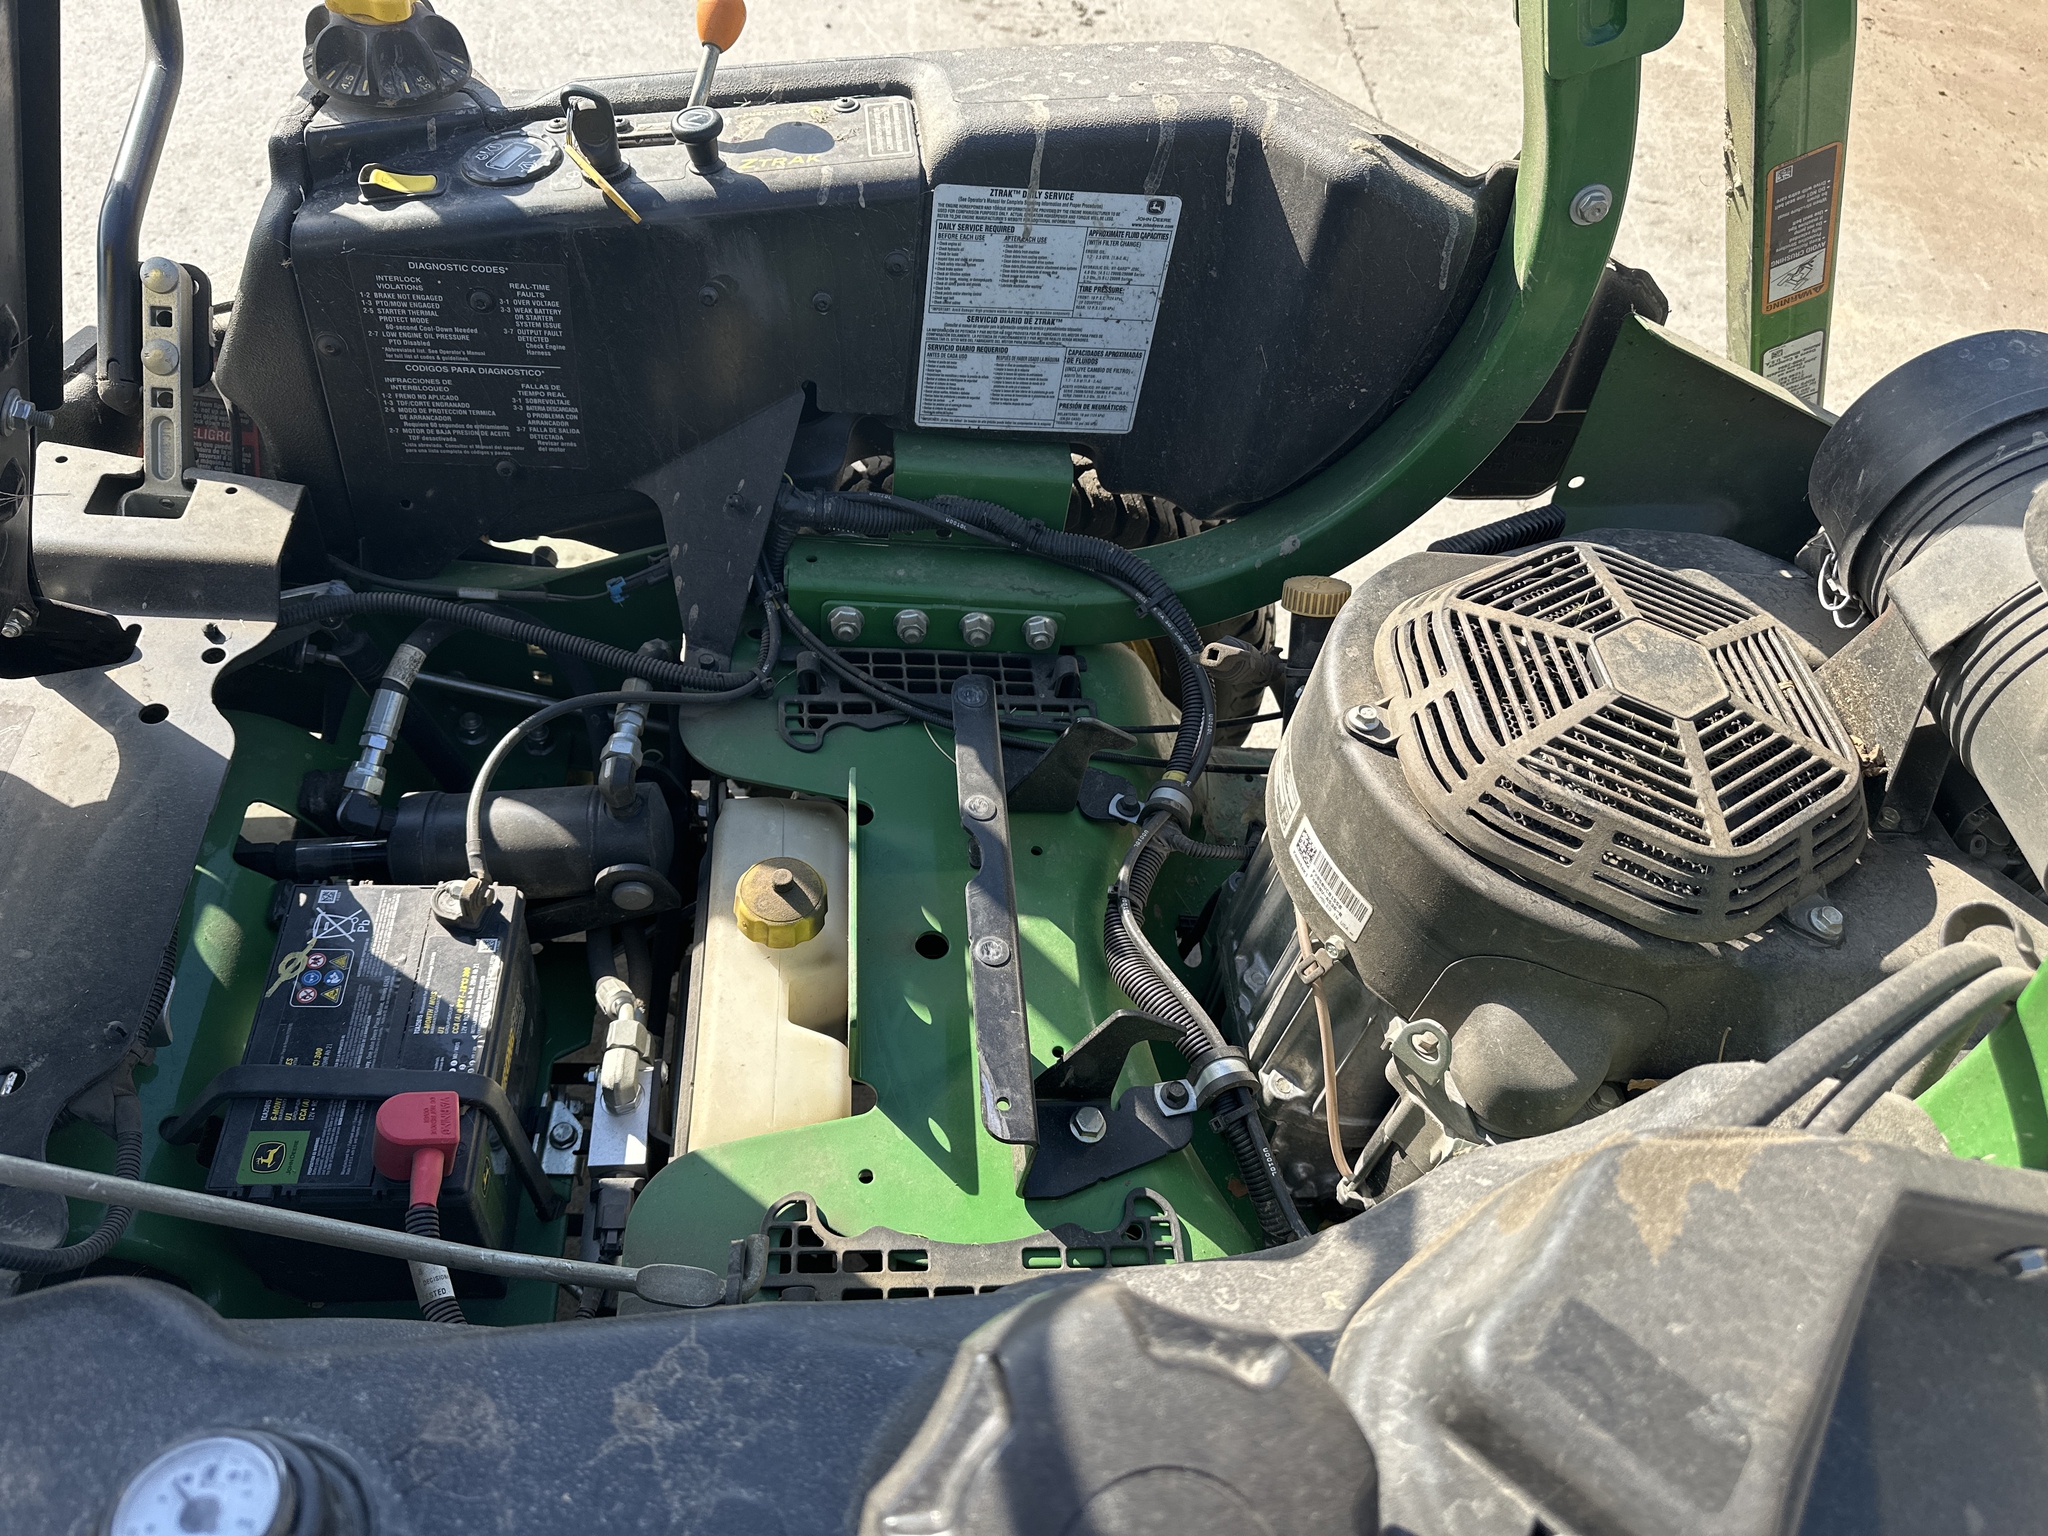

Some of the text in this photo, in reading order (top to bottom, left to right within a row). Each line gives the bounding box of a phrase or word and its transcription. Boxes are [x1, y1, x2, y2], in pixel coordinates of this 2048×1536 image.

[341, 74, 354, 90] 4.5
[739, 156, 820, 170] ZTRAK
[1022, 191, 1042, 199] DLY
[1044, 191, 1074, 200] SERVICE
[985, 225, 1015, 233] REQUIRED
[1089, 230, 1169, 240] APPROXIMATE FLUID CAPACITIES
[1770, 241, 1826, 266] AVOID CRUSHING
[408, 261, 468, 272] DIAGNOSTIC
[376, 283, 424, 291] VIOLATIONS
[1765, 289, 1812, 312] WARNING
[405, 364, 449, 373] CODIGOS
[451, 366, 476, 374] PARA
[193, 427, 232, 442] ELIGRO
[357, 919, 370, 933] Pb
[424, 1009, 434, 1034] 6-MONTH
[429, 991, 437, 1005] MOIS
[314, 1047, 323, 1059] 300
[271, 1097, 282, 1121] 6-MONT
[299, 1108, 308, 1121] CCA
[285, 1112, 293, 1121] U1
[291, 1140, 299, 1159] DEERE
[426, 1287, 447, 1298] STED
